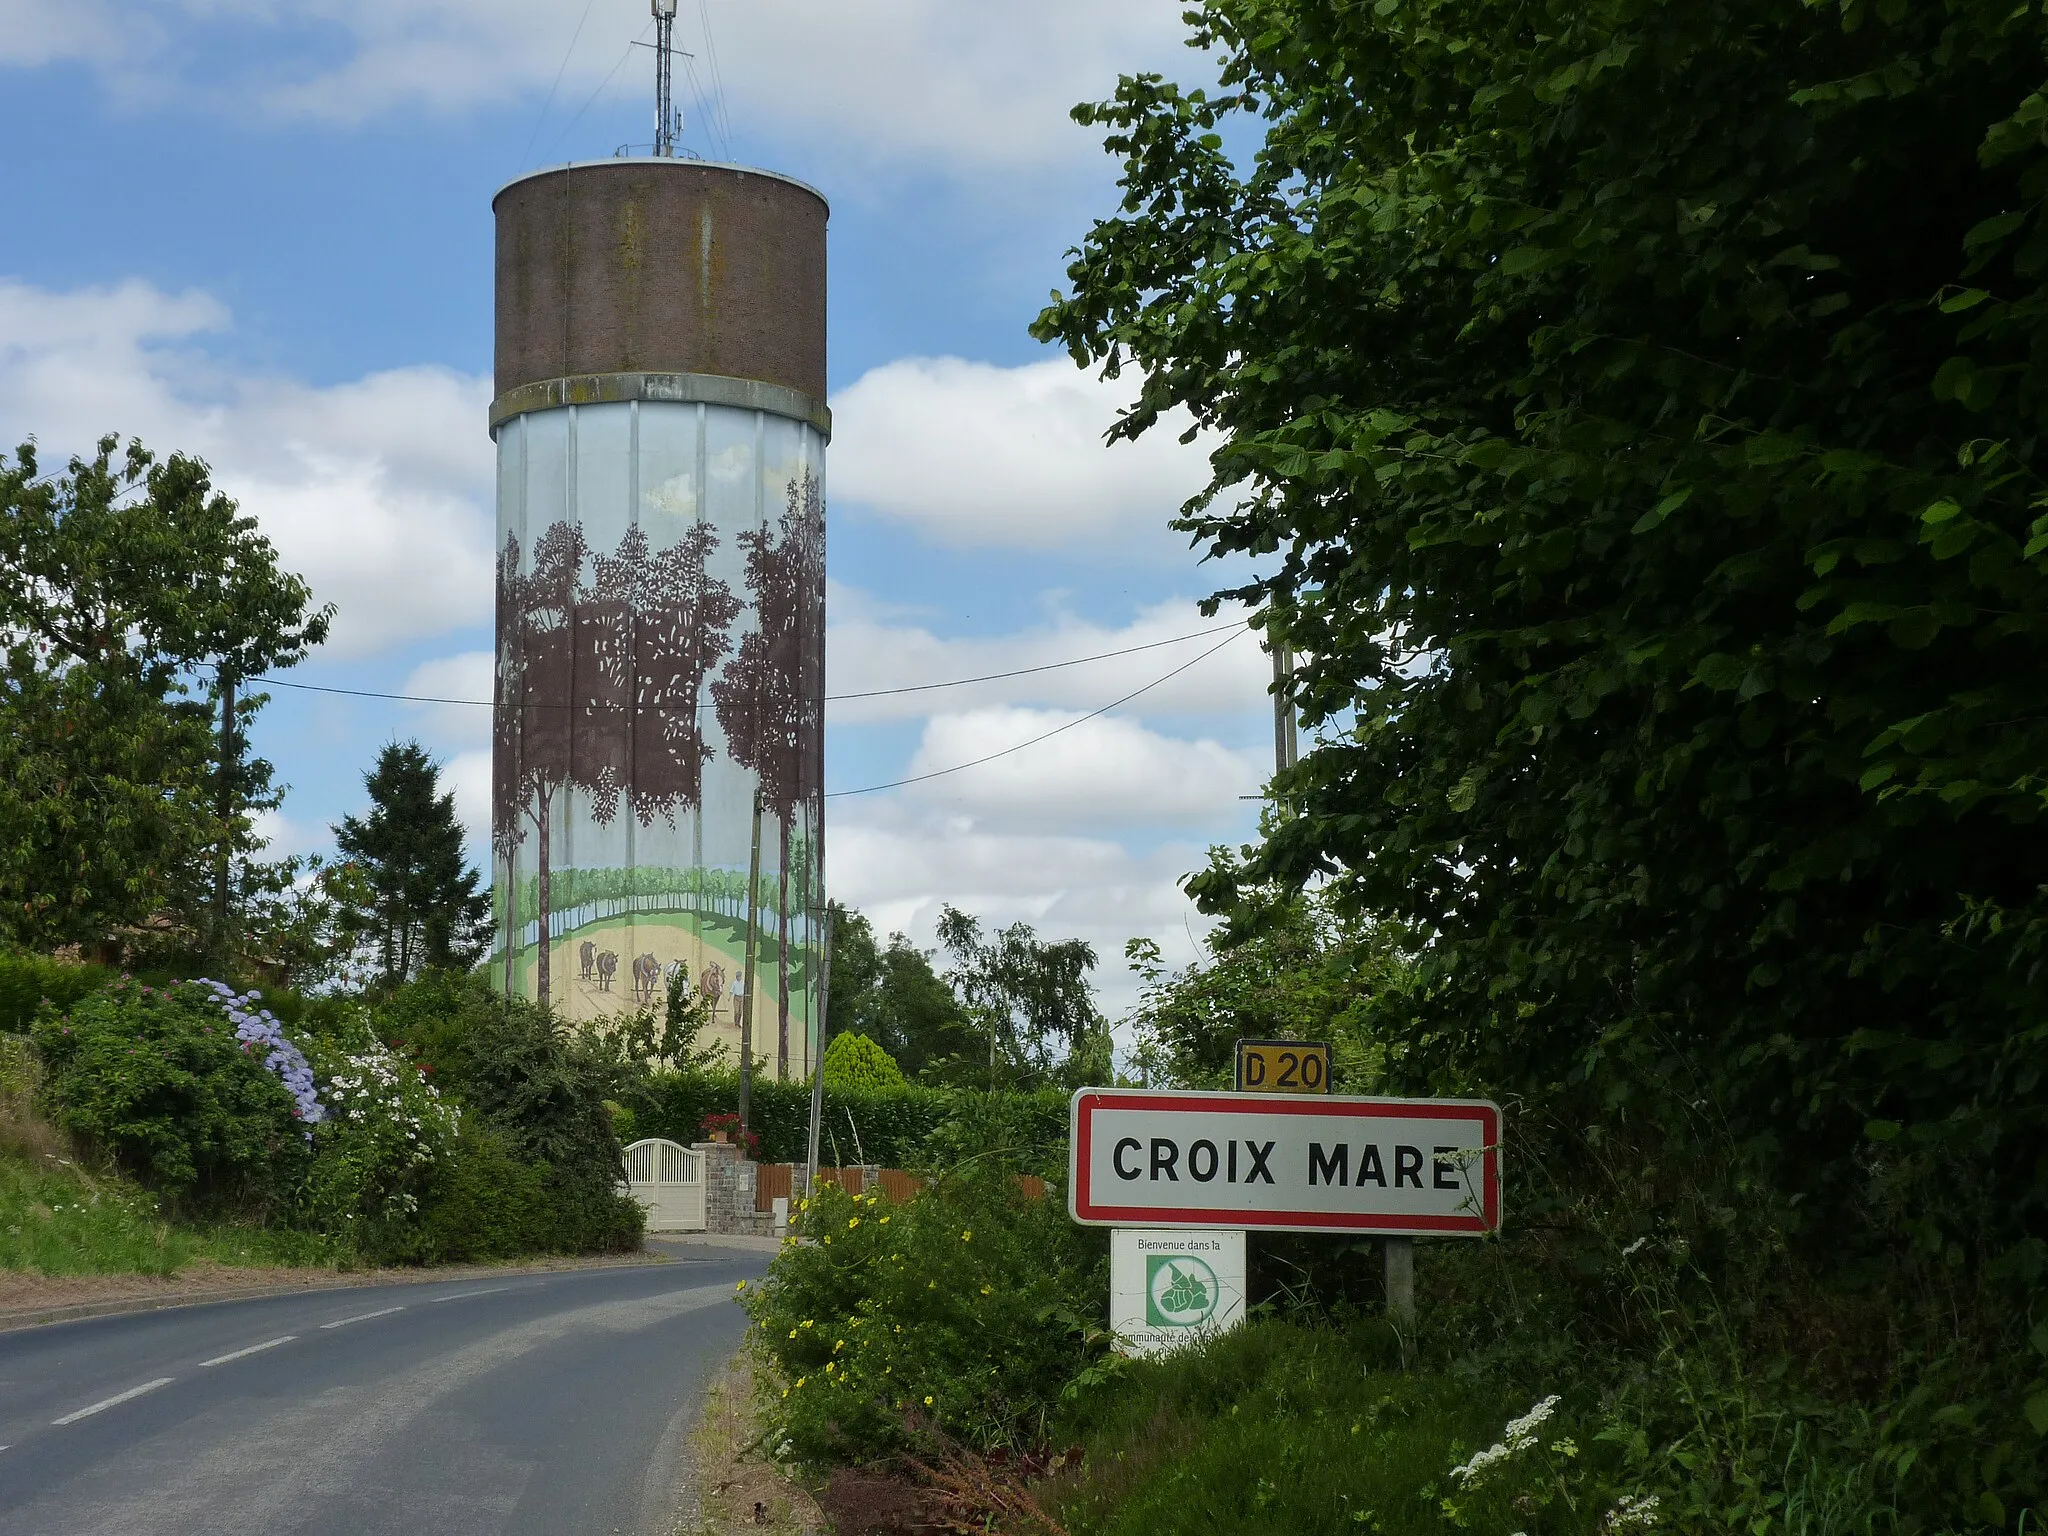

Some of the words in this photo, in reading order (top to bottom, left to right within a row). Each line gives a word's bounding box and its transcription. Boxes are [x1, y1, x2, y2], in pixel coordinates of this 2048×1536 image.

[1246, 1052, 1265, 1086] D
[1276, 1052, 1322, 1088] 20
[1112, 1137, 1276, 1184] CROIX
[1308, 1142, 1461, 1190] MARE
[1138, 1239, 1185, 1250] Bienvenue
[1187, 1240, 1210, 1251] dans
[1211, 1240, 1221, 1251] la
[1178, 1332, 1190, 1342] de
